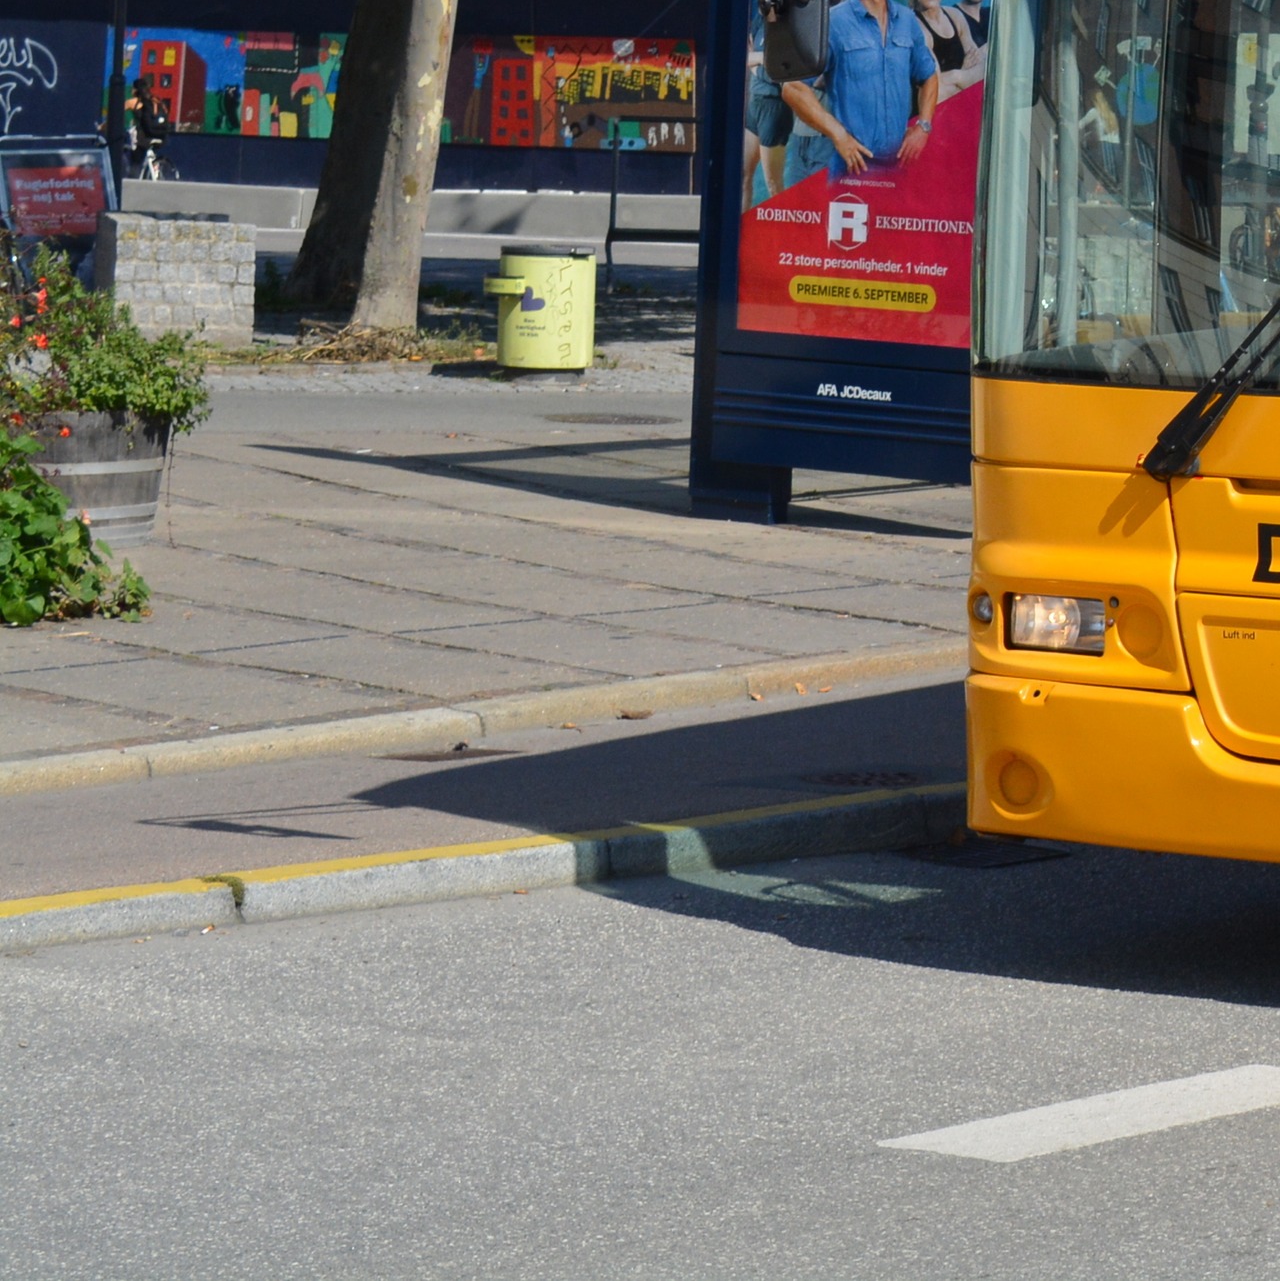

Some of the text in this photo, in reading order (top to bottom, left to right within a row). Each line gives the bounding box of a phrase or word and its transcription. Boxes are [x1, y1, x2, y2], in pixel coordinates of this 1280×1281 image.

[15, 179, 95, 190] Fuglefodring
[862, 180, 896, 188] PRODUCTION
[54, 192, 75, 201] tak
[756, 207, 822, 223] ROBINSON
[875, 215, 974, 234] EKSPEDITIONEN
[779, 253, 948, 276] 22 store personligheder. 1 vinder
[796, 283, 928, 304] PREMIERE 6. SEPTEMBER
[817, 383, 892, 401] AFA JCDecaux
[1222, 630, 1256, 640] Luft ind
